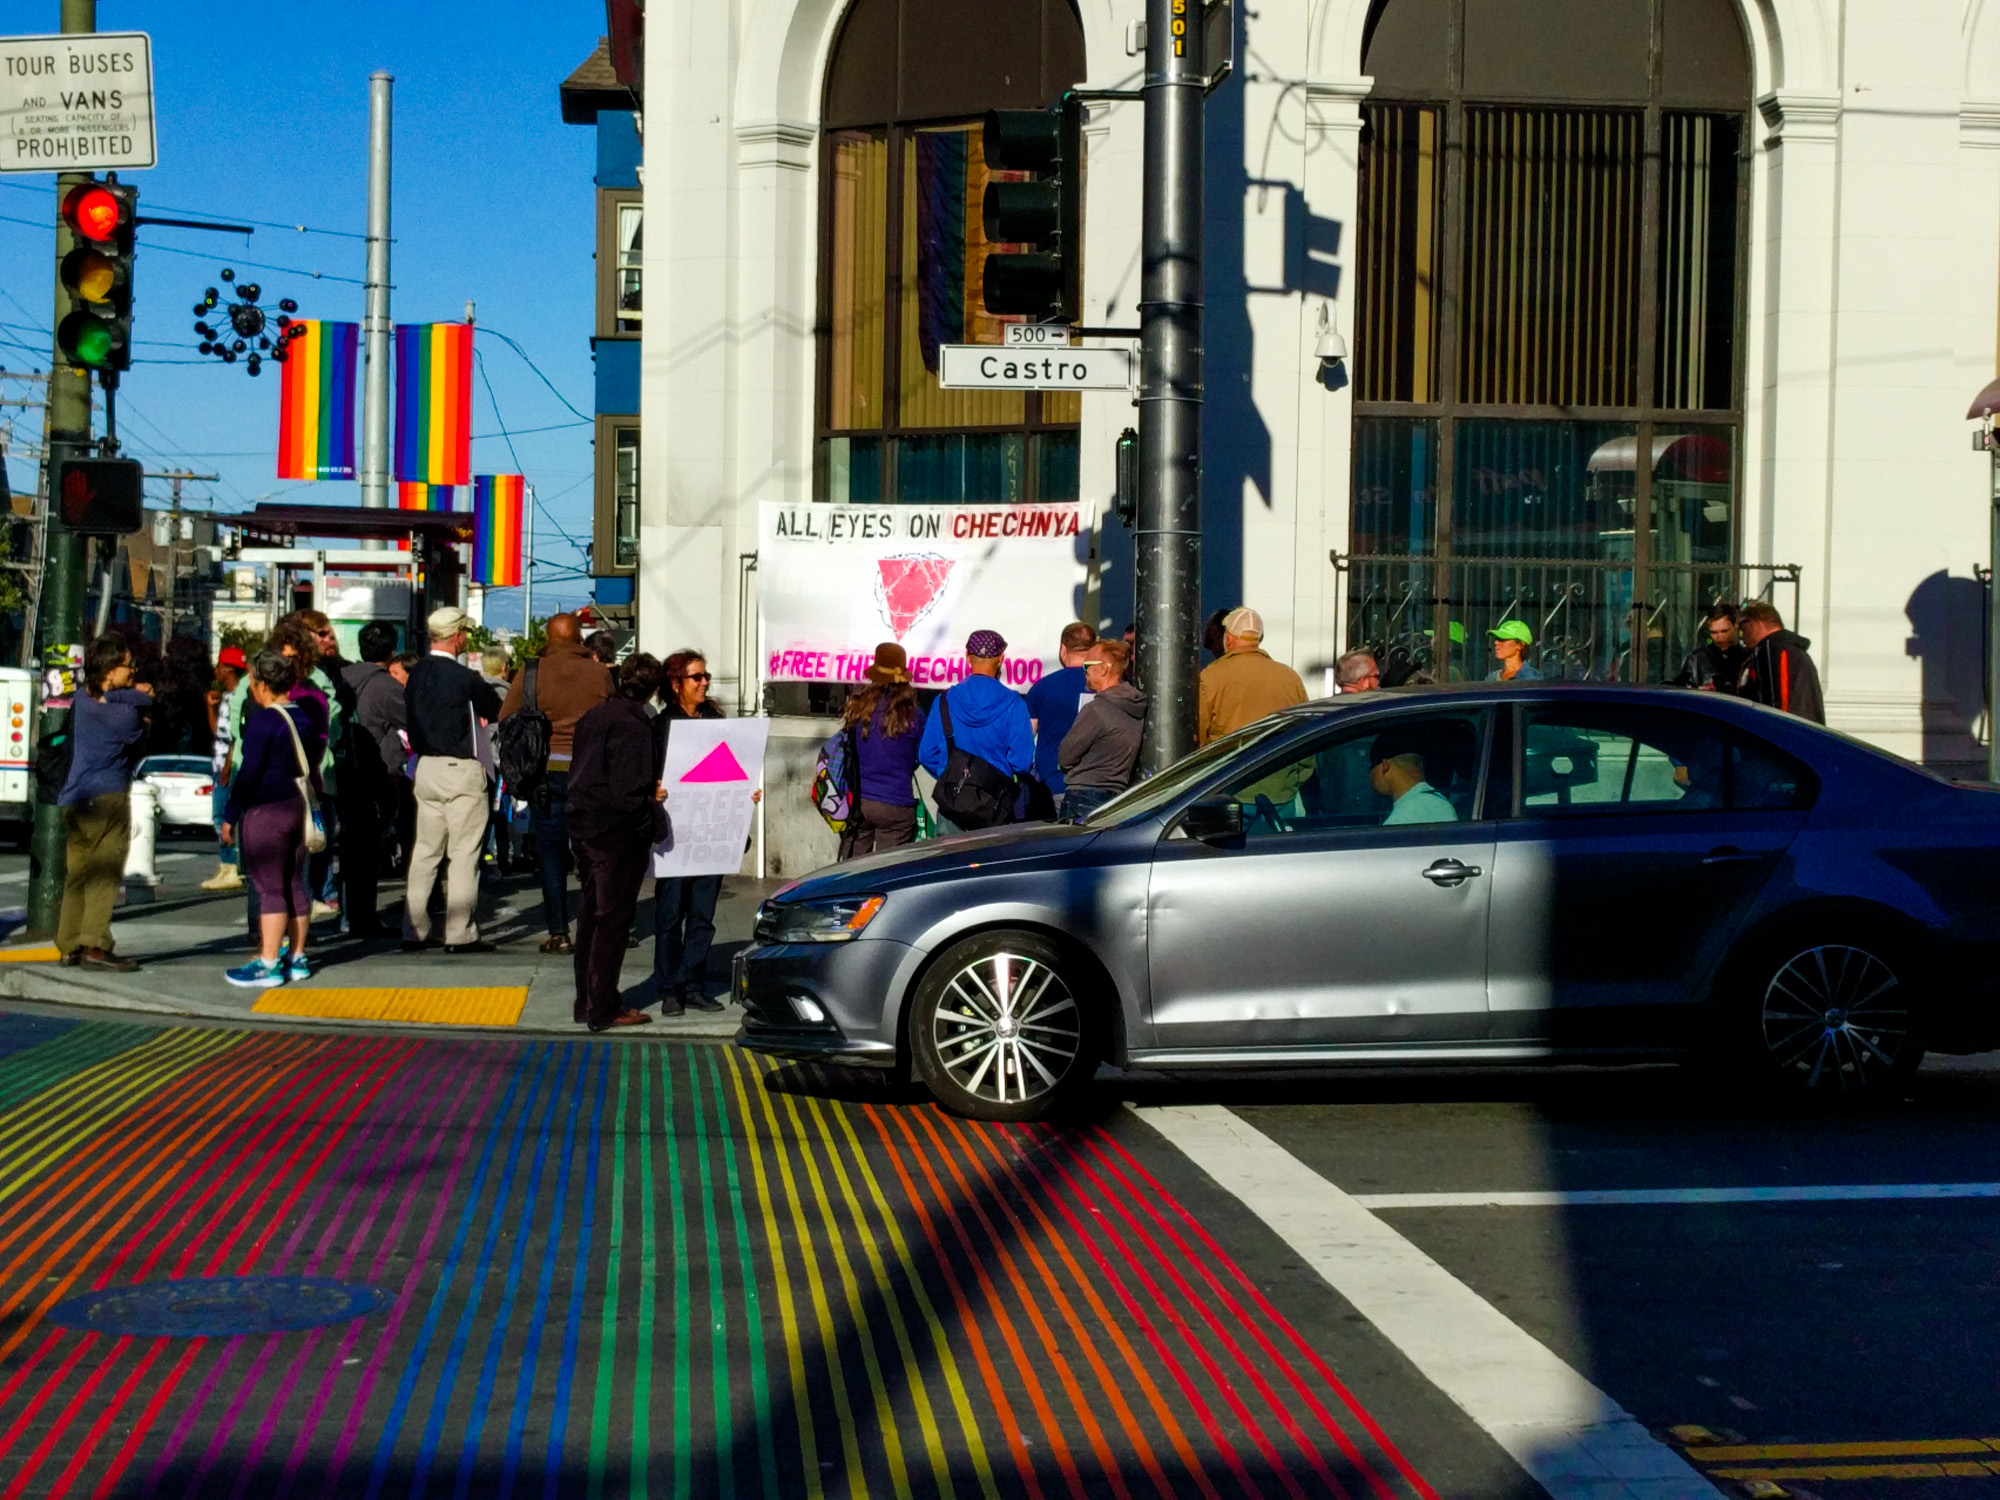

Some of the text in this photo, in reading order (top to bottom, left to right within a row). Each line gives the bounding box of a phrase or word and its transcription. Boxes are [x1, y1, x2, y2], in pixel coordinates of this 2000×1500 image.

[6, 53, 135, 76] TOUR BUSES
[22, 90, 123, 110] AND VANS
[24, 115, 60, 124] SEATING
[65, 113, 106, 122] CAPACITY
[47, 125, 70, 134] MORE
[76, 123, 131, 133] PASSENGERS
[16, 136, 133, 158] PROHIBITED
[1012, 327, 1047, 343] 500
[980, 356, 1088, 380] Castro
[776, 511, 1081, 539] ALL EYES ON CHECHNYA
[769, 649, 831, 679] #FREE
[1004, 657, 1044, 686] 100
[669, 789, 749, 822] FREE
